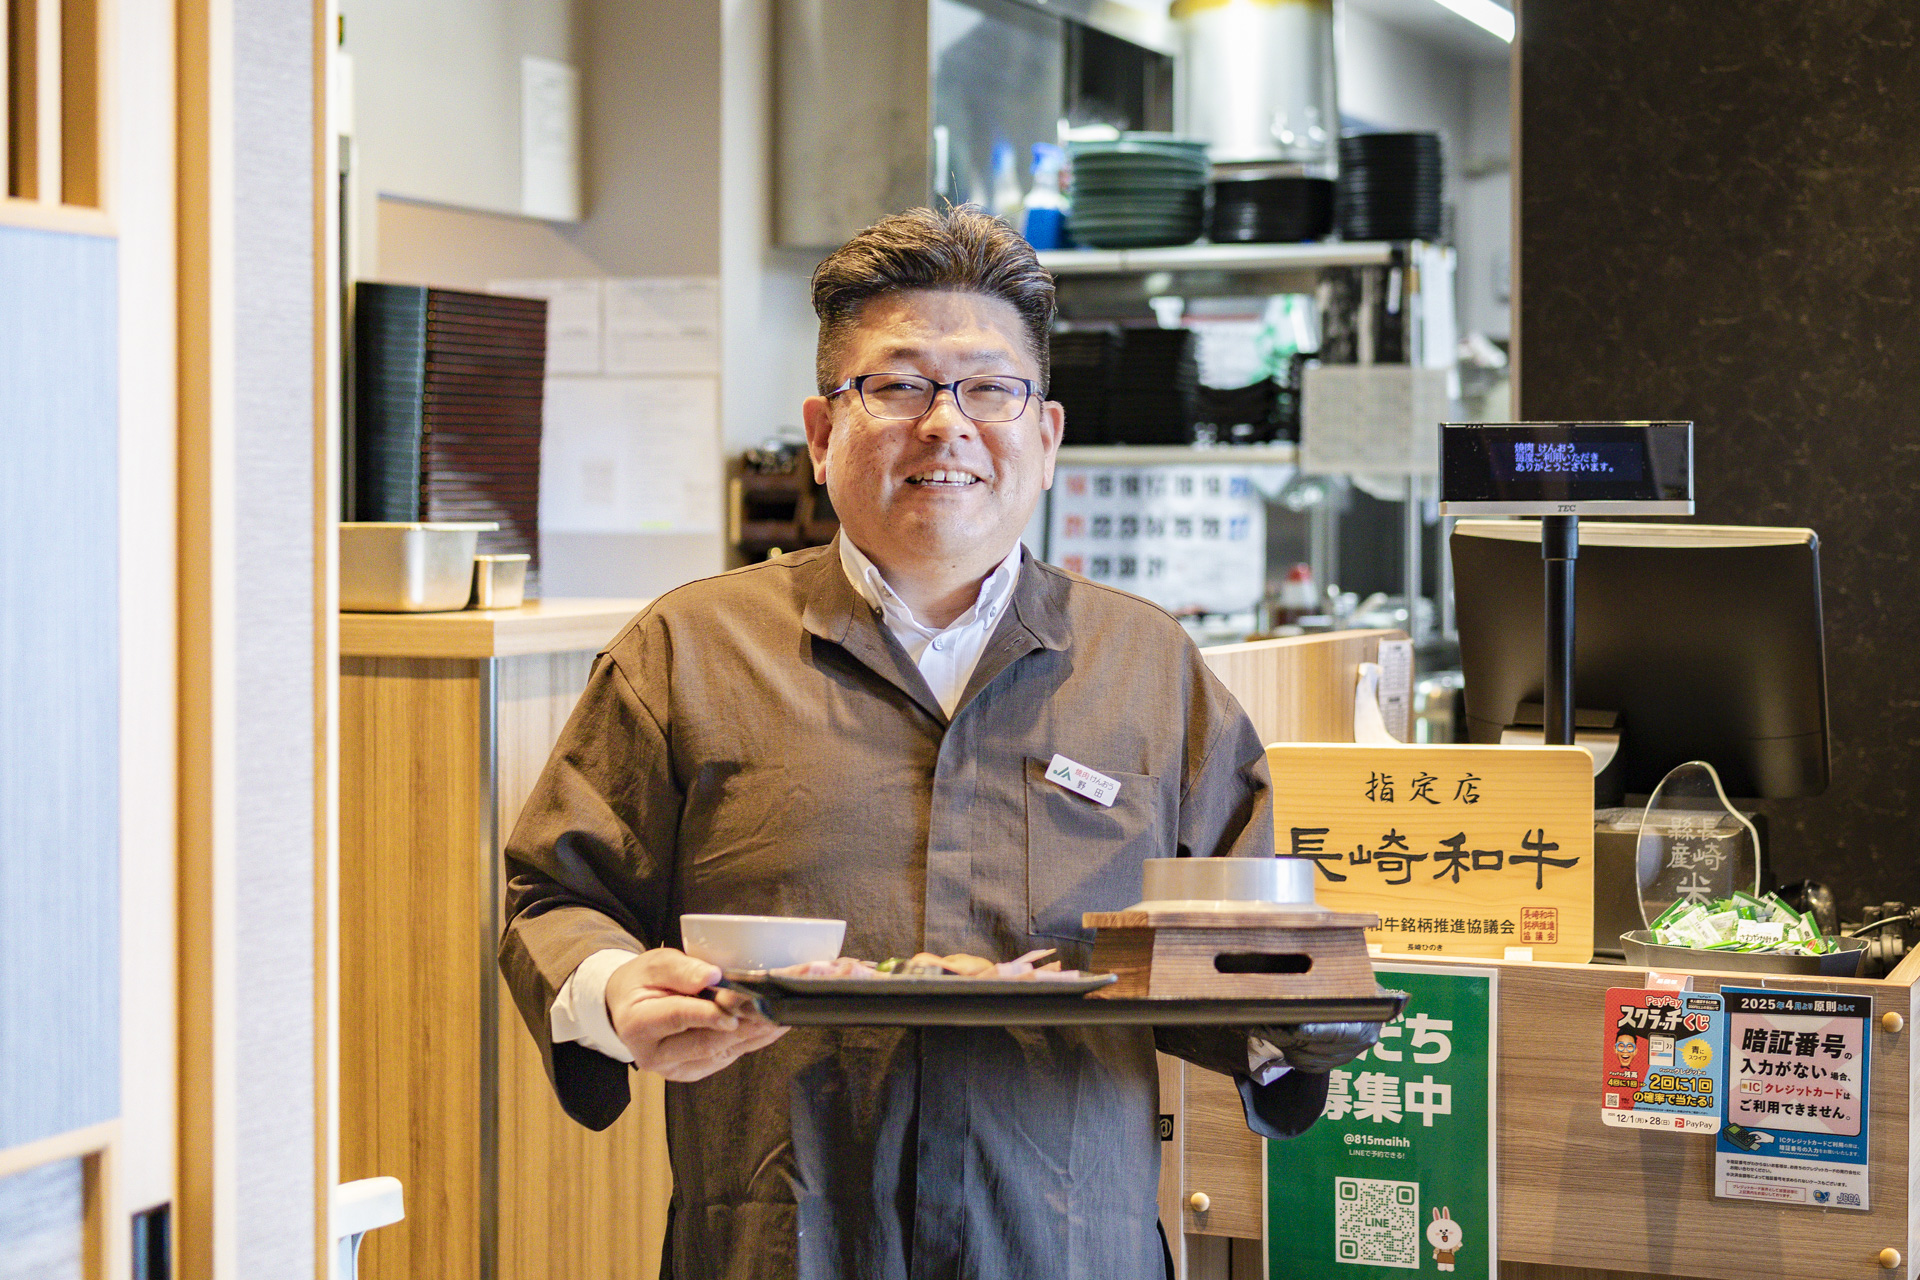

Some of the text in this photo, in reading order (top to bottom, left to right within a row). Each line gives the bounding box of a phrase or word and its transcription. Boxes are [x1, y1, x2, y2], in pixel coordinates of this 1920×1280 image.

[1538, 442, 1575, 453] けんおう
[1515, 461, 1614, 472] ありがとうございます。
[1090, 775, 1114, 791] けんおう
[1365, 771, 1481, 805] 指定店
[1275, 827, 1580, 890] 長崎和牛
[1407, 943, 1443, 952] 長崎ひのき
[1645, 995, 1683, 1009] PayPay
[1741, 998, 1855, 1012] 2025年4月より原則として
[1618, 1005, 1710, 1032] スクラッチくじ
[1741, 1028, 1853, 1060] 暗証番号の
[1649, 1073, 1713, 1093] 2回に1回
[1633, 1091, 1713, 1108] の確率で当たる!
[1740, 1100, 1851, 1121] ご利用できません。
[1686, 1120, 1713, 1130] PayPay
[1343, 1133, 1411, 1148] @815maihh
[1364, 1217, 1390, 1229] LINE
